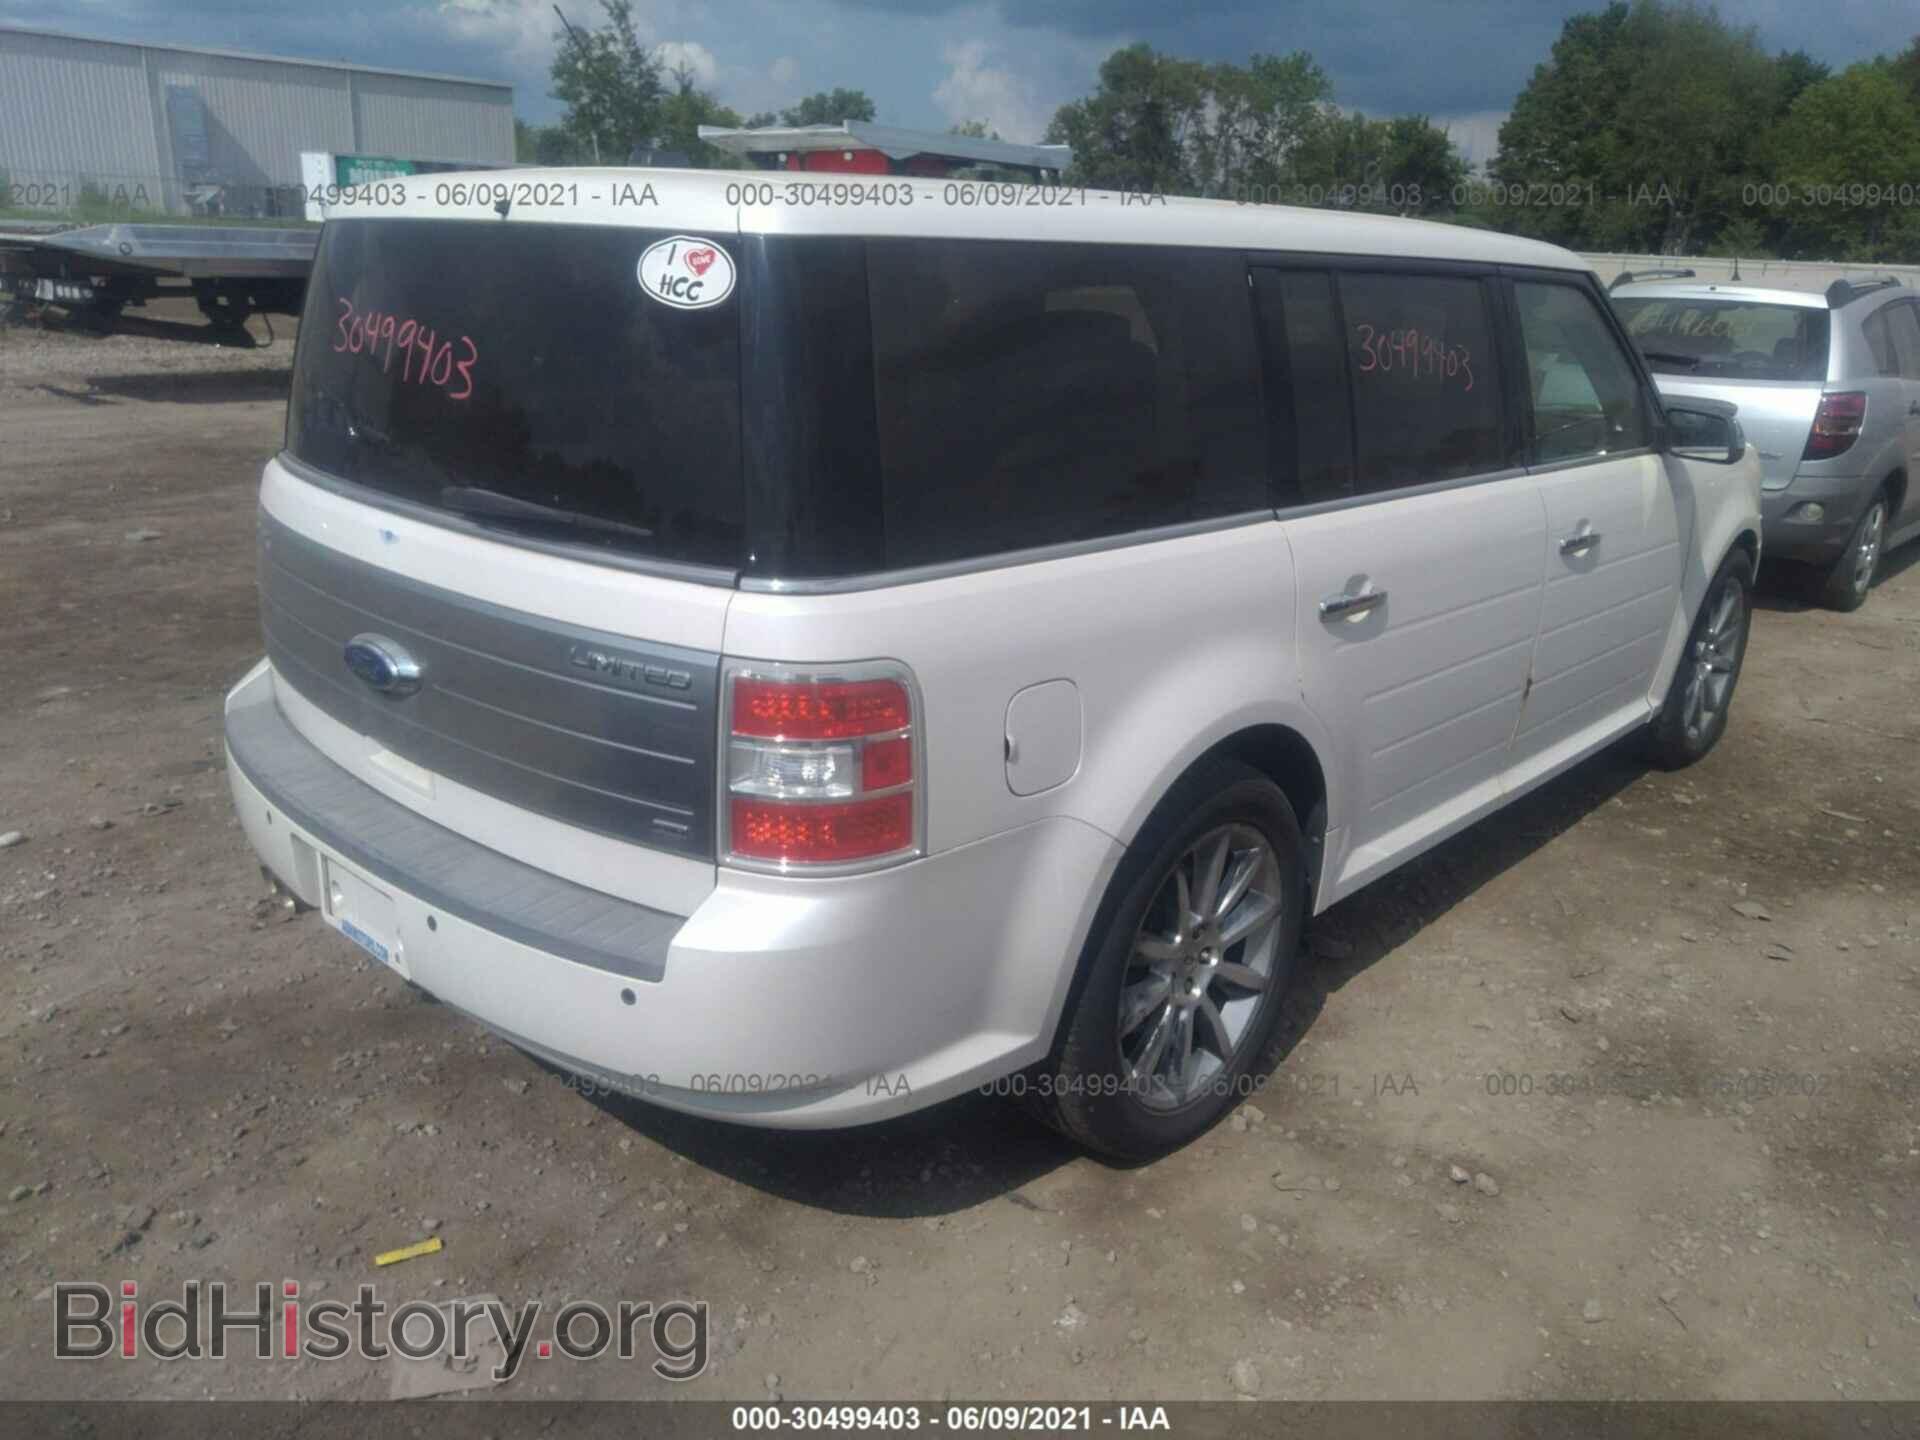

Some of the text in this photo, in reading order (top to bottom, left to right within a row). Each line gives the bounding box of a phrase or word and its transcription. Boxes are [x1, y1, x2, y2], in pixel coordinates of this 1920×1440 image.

[659, 273, 704, 301] HCC
[334, 296, 478, 400] 30499403
[1357, 323, 1474, 392] 30499403
[569, 645, 693, 691] LIMITED
